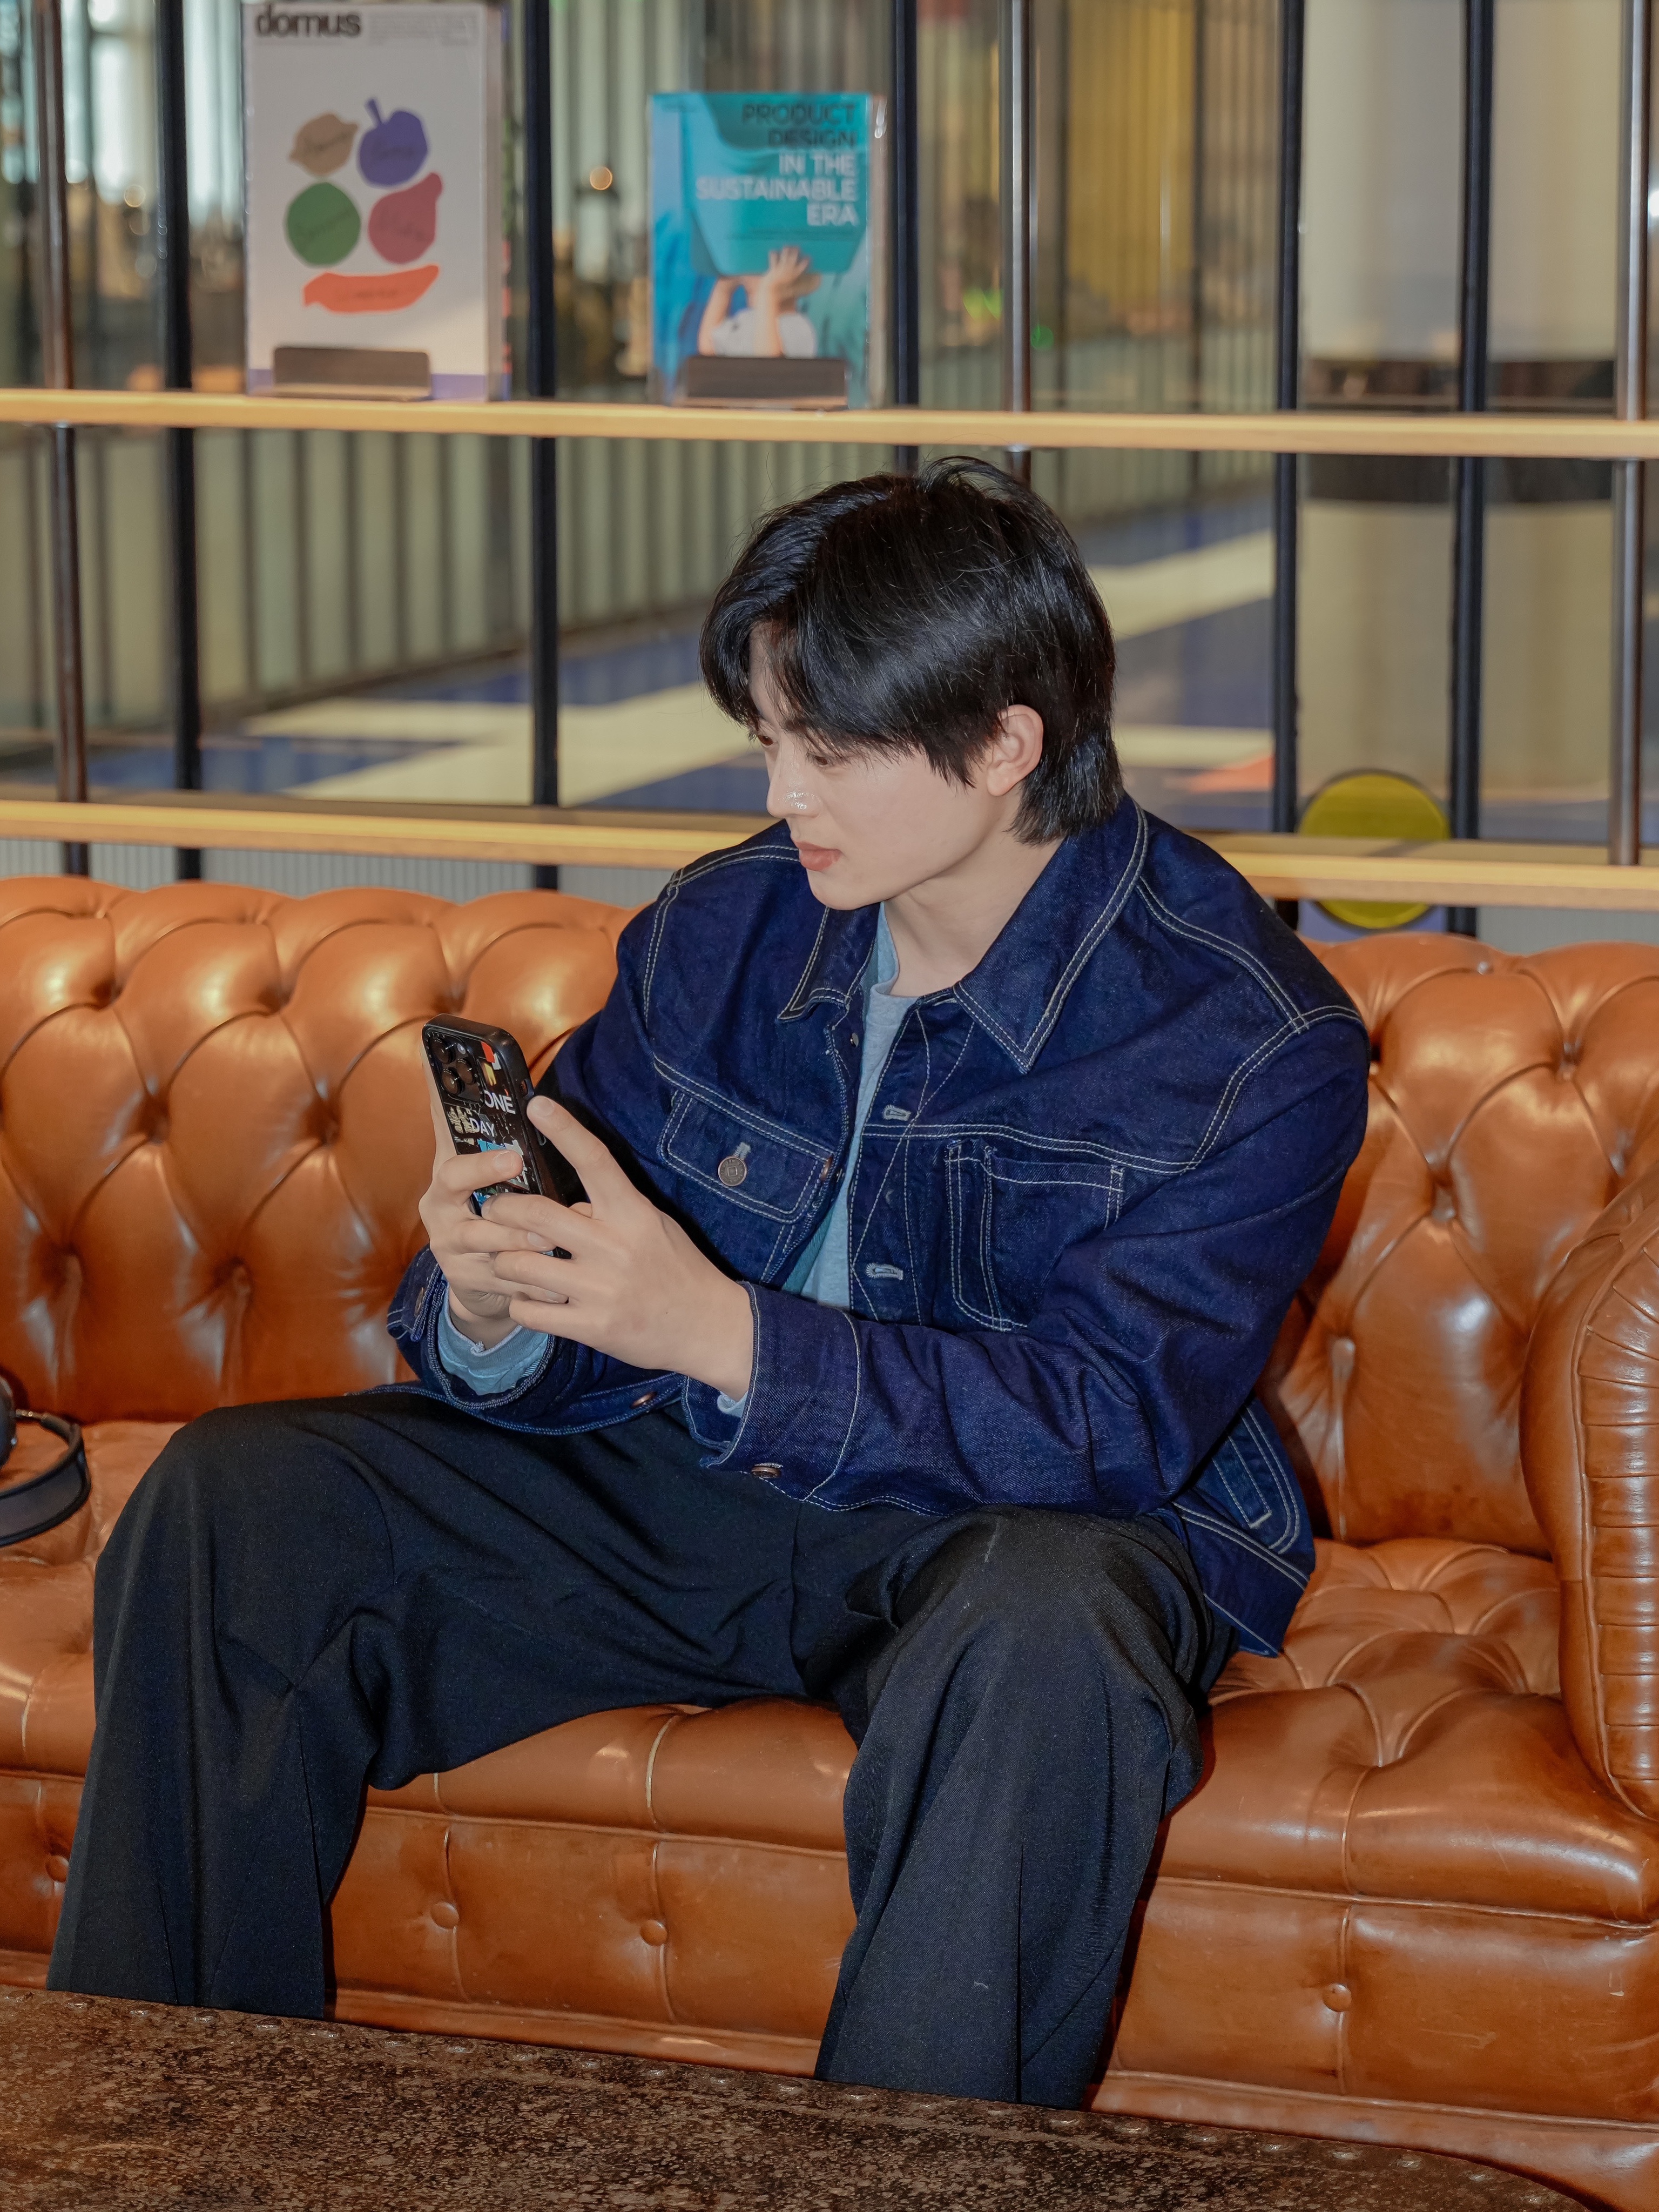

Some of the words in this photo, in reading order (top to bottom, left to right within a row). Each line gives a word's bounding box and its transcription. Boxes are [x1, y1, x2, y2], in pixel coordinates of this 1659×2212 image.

[255, 3, 361, 37] domus
[741, 103, 857, 125] PRODUCT
[768, 129, 858, 147] DESIGN
[779, 152, 805, 175] IN
[812, 151, 856, 177] THE
[696, 177, 857, 201] SUSTAINABLE
[807, 203, 858, 226] ERA
[484, 1090, 516, 1114] ONE
[469, 1118, 495, 1137] DAY
